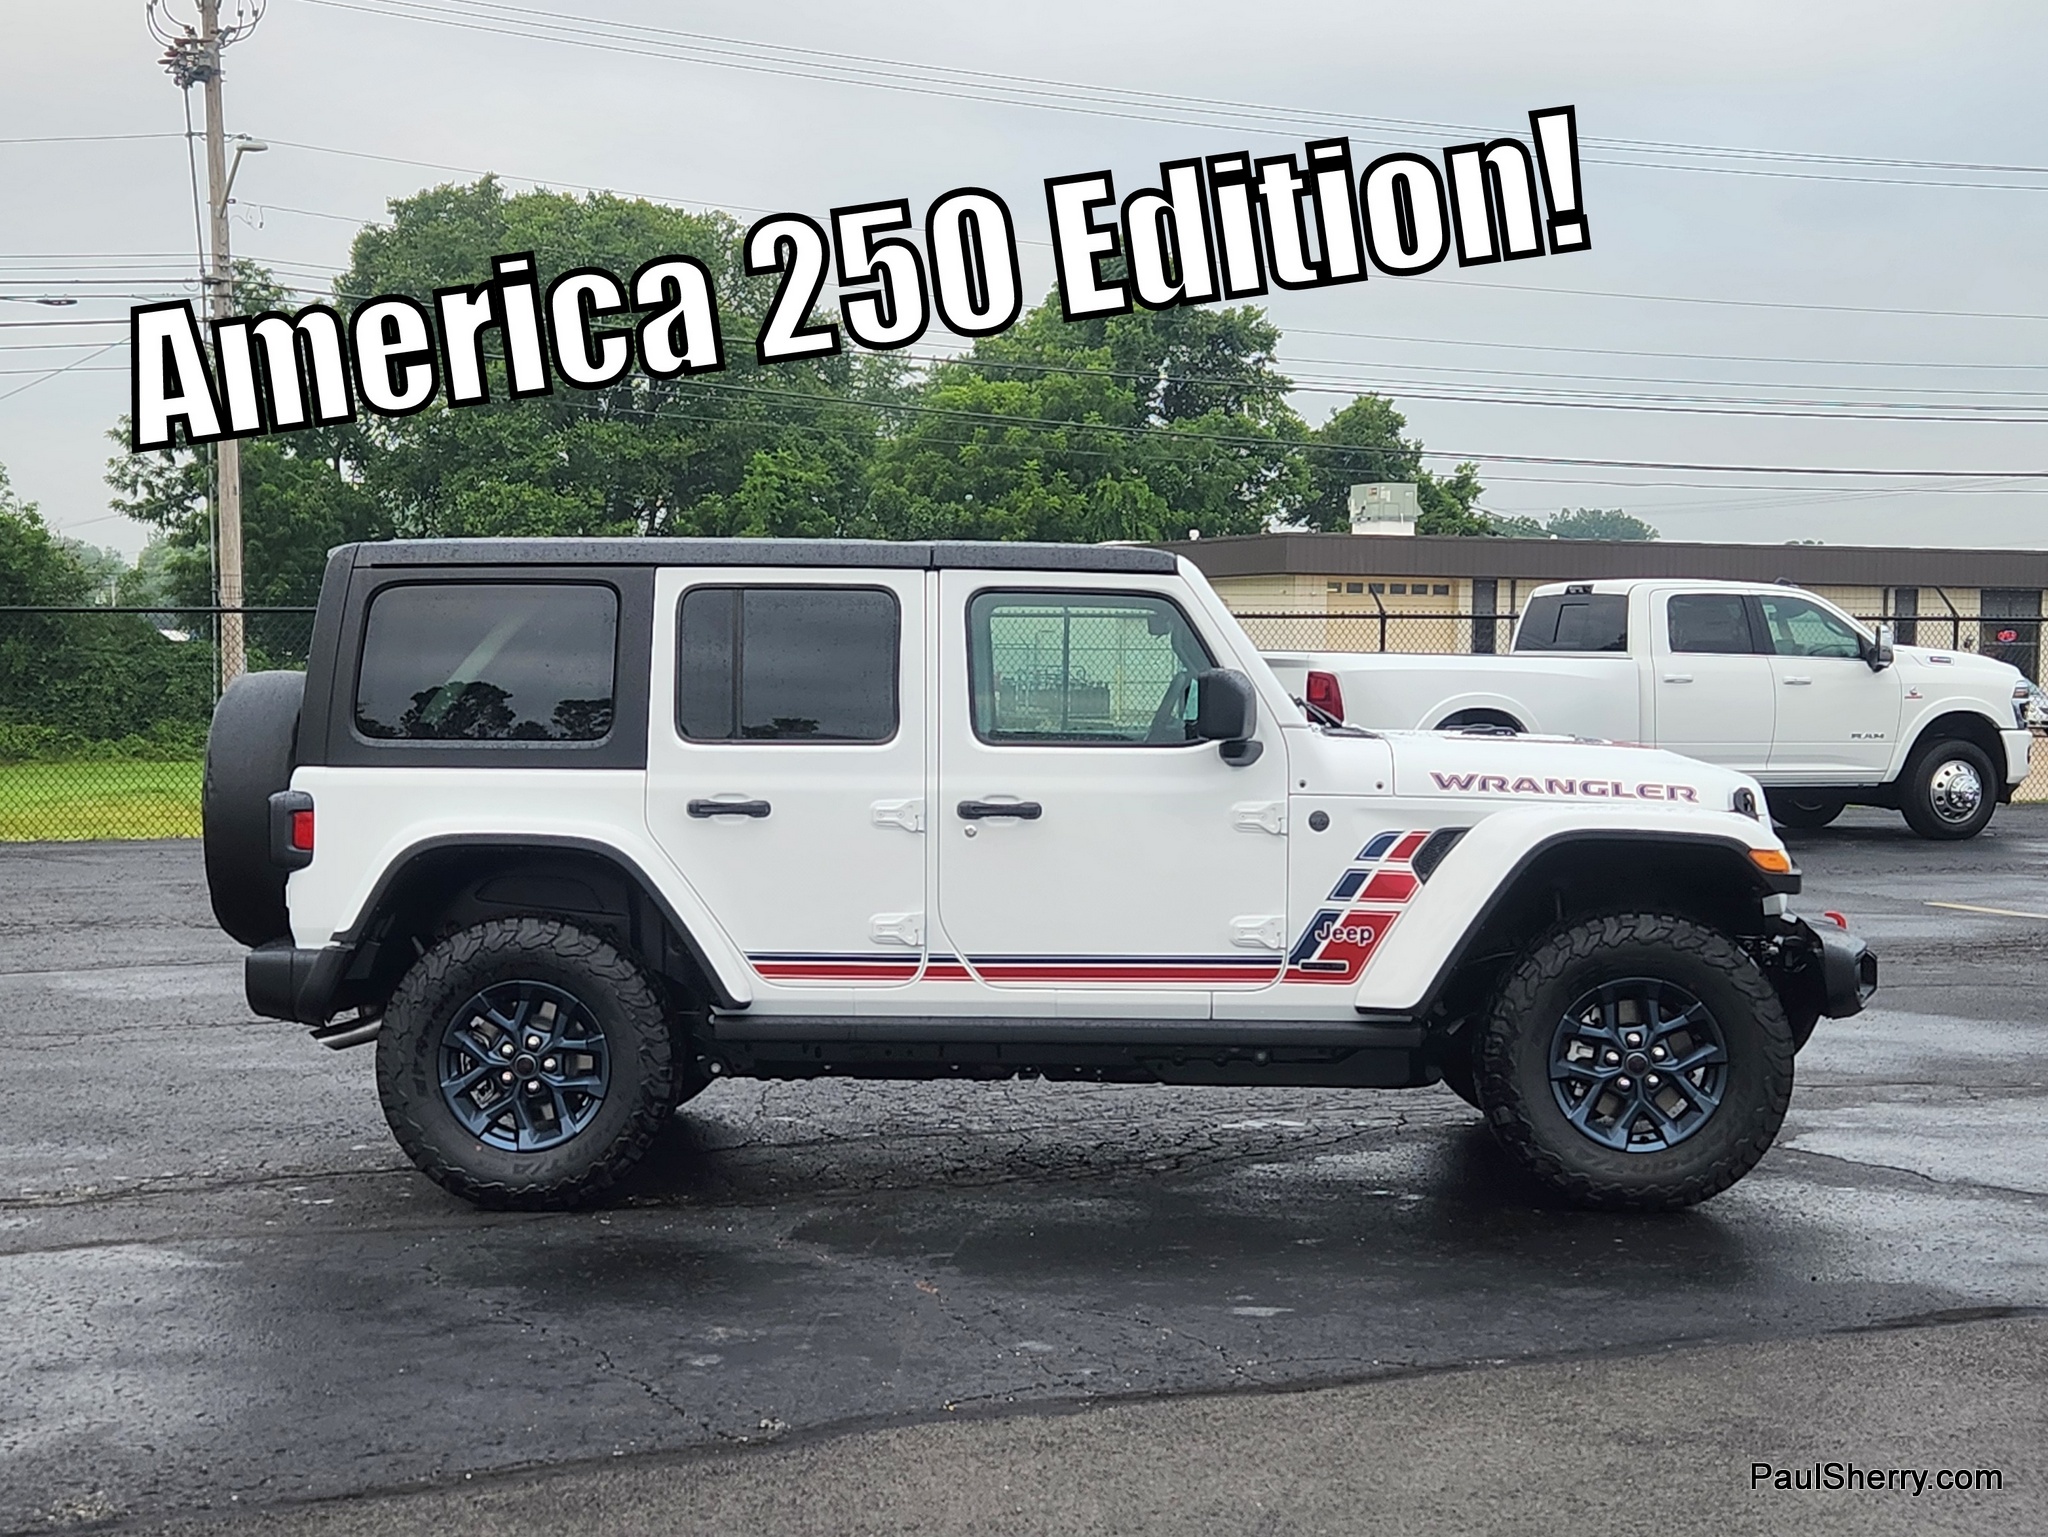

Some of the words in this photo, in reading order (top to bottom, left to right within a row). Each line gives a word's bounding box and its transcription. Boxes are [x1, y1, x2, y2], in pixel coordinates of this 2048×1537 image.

[1850, 732, 1885, 740] RAM
[1428, 771, 1700, 804] WRANGLER
[1315, 921, 1374, 946] Jeep
